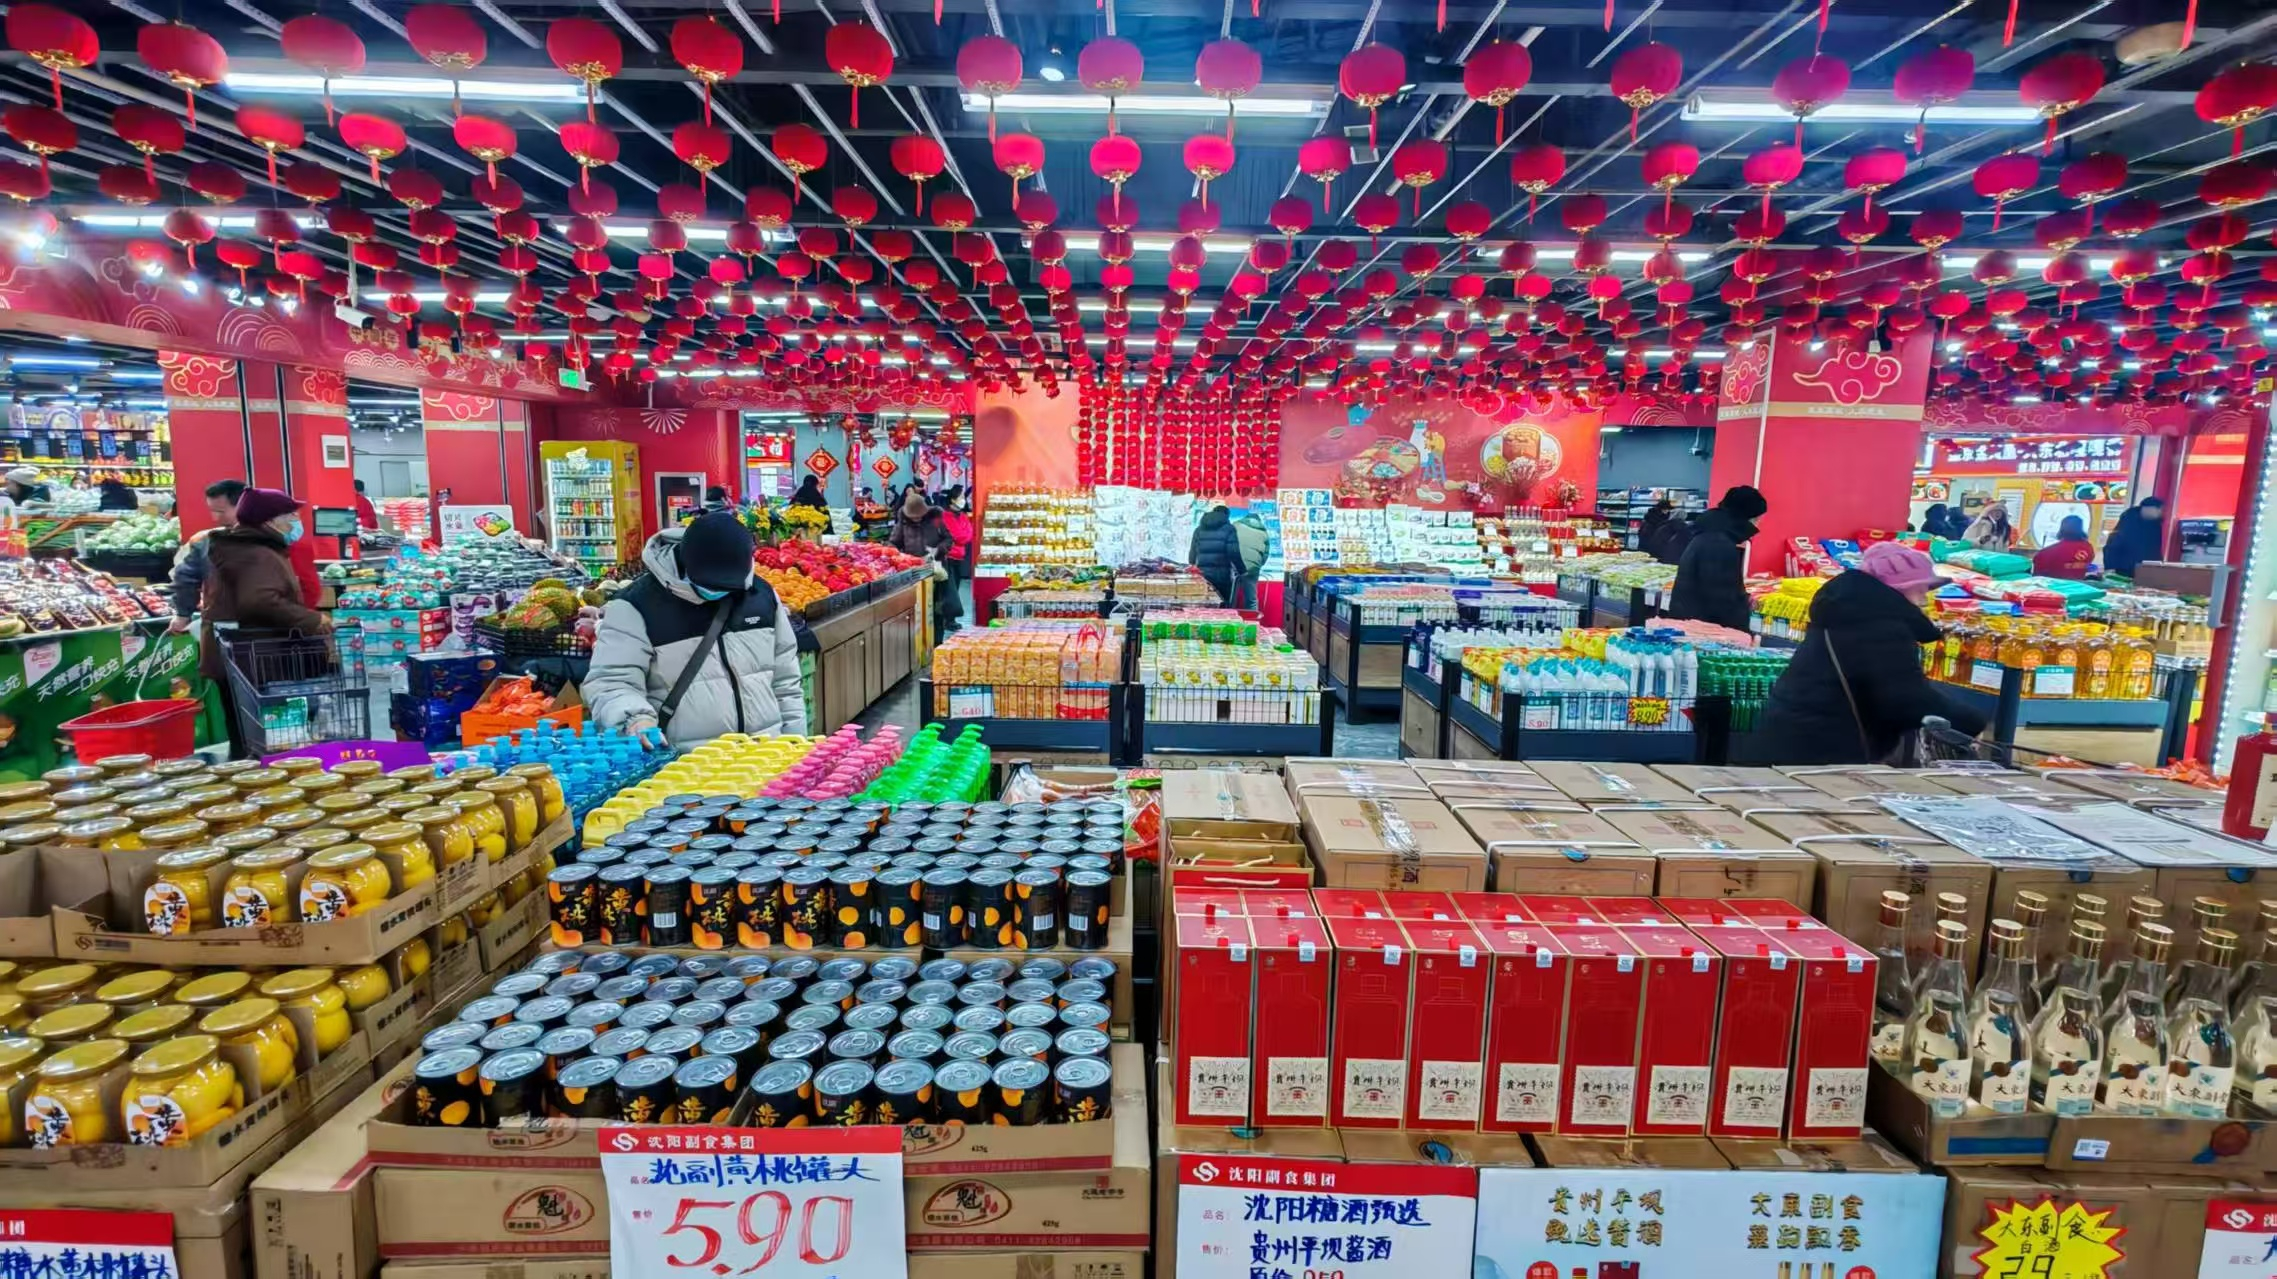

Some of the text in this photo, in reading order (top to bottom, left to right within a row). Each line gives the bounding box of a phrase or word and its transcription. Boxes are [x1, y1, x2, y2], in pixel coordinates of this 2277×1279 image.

[0, 672, 21, 696] 充
[647, 1134, 755, 1150] 沈阳副食集团
[1229, 1166, 1337, 1188] 沈阳副食集团
[1243, 1193, 1432, 1227] 沈阳糖酒甄选
[1548, 1185, 1666, 1216] 贵州平坝
[660, 1190, 855, 1275] 5.90
[2020, 1237, 2061, 1255] 白酒
[1249, 1229, 1393, 1267] 贵州平坝酱酒
